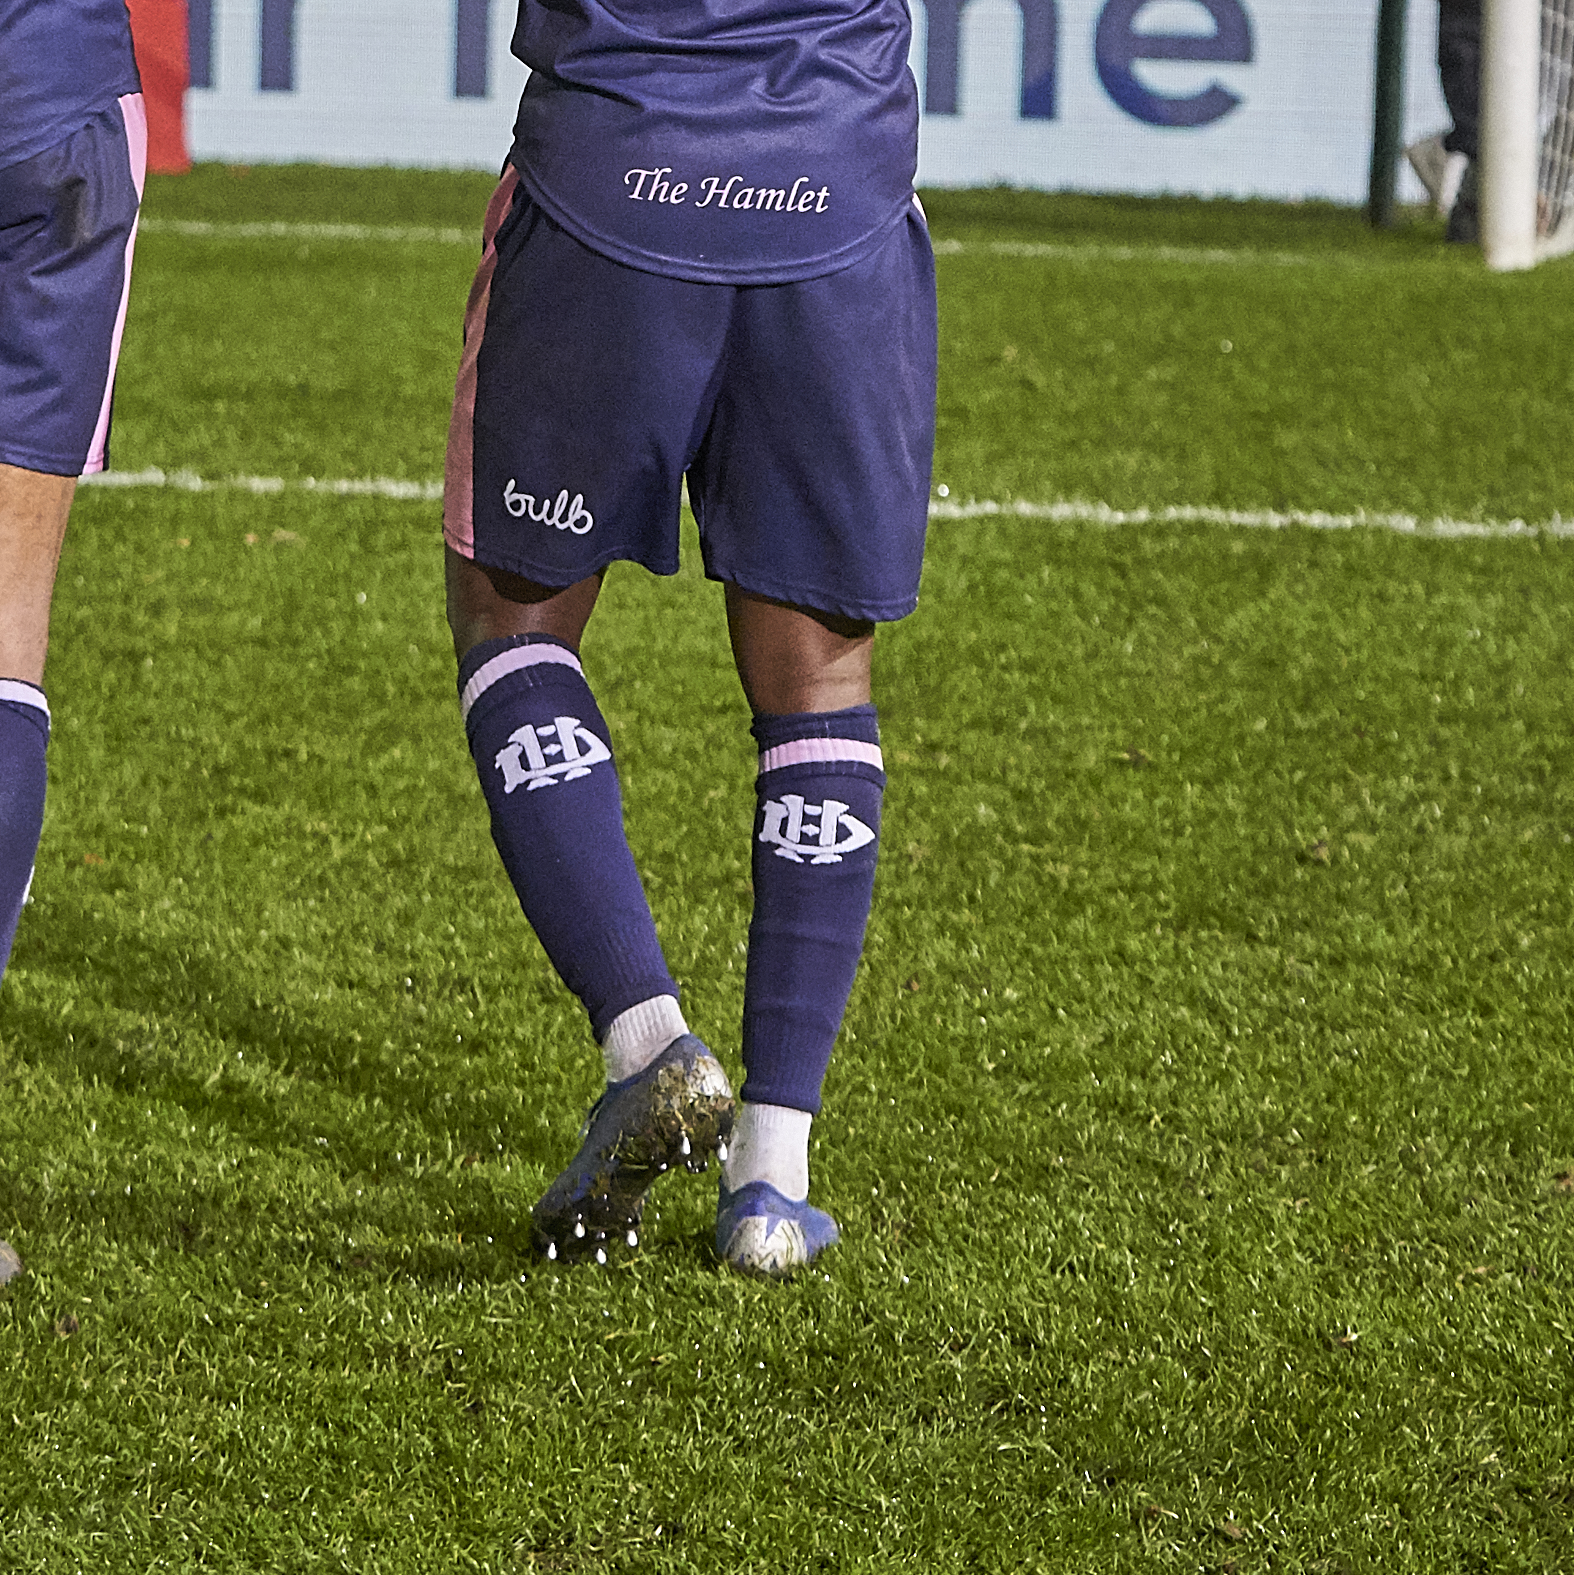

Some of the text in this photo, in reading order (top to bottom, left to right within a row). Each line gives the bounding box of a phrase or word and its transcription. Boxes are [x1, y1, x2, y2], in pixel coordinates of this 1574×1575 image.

[624, 167, 831, 214] The Hamlet
[503, 478, 594, 535] bulb
